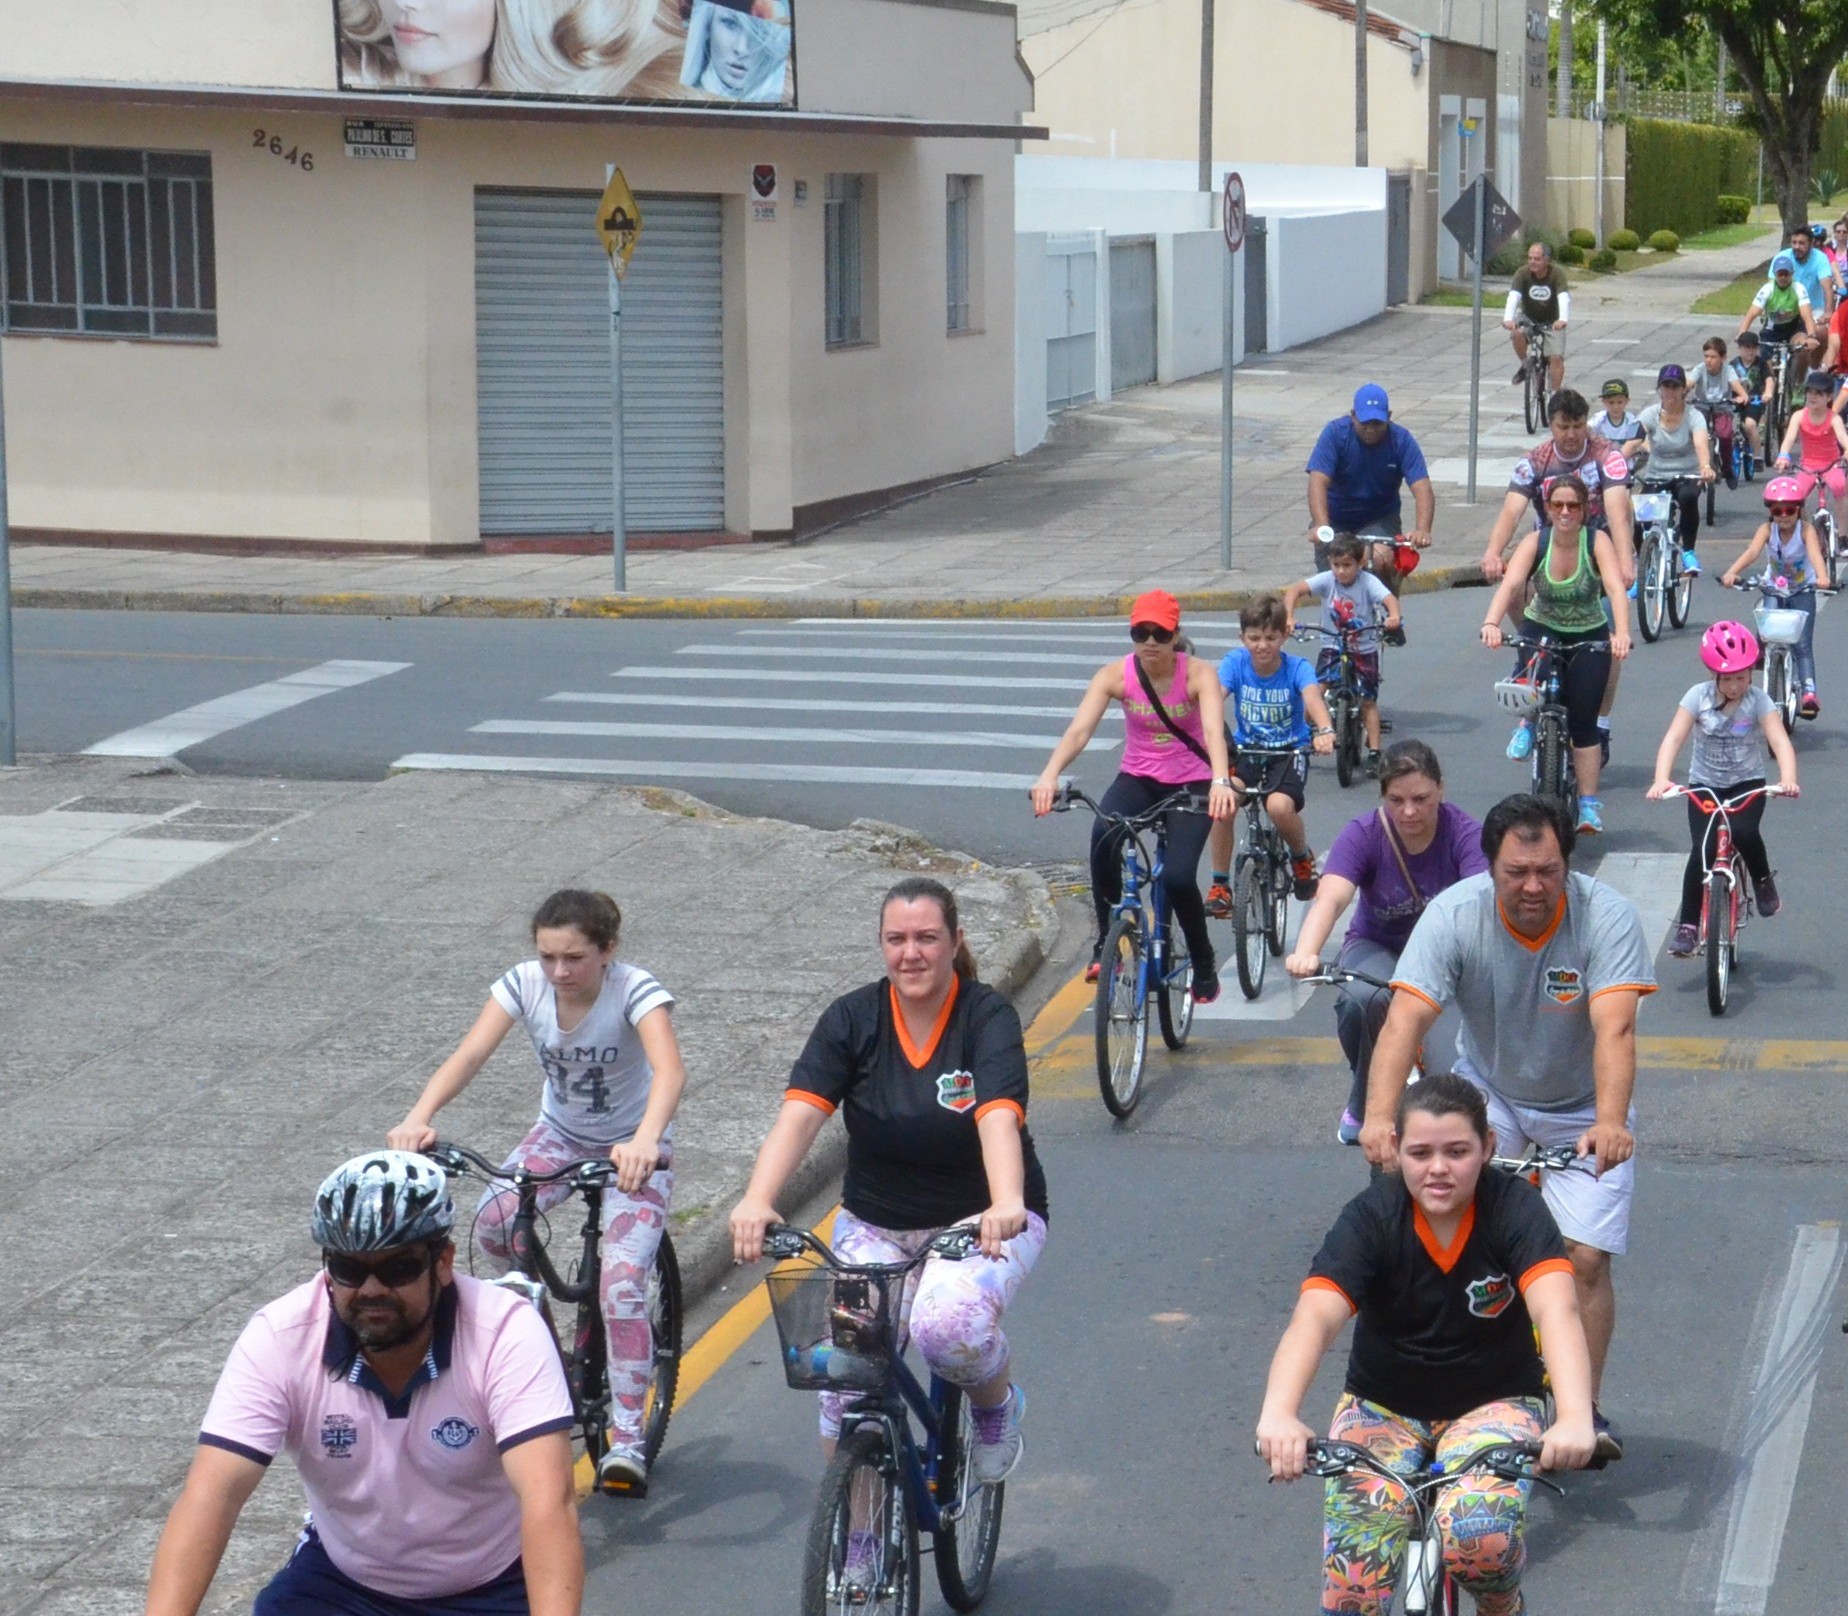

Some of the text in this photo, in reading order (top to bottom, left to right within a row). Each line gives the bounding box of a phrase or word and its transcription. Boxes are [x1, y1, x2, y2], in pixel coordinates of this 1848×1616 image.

[252, 129, 315, 171] 2646
[353, 145, 409, 158] RENAULT
[1241, 685, 1290, 703] RIDE YOUR
[1240, 703, 1293, 723] BICYCLE
